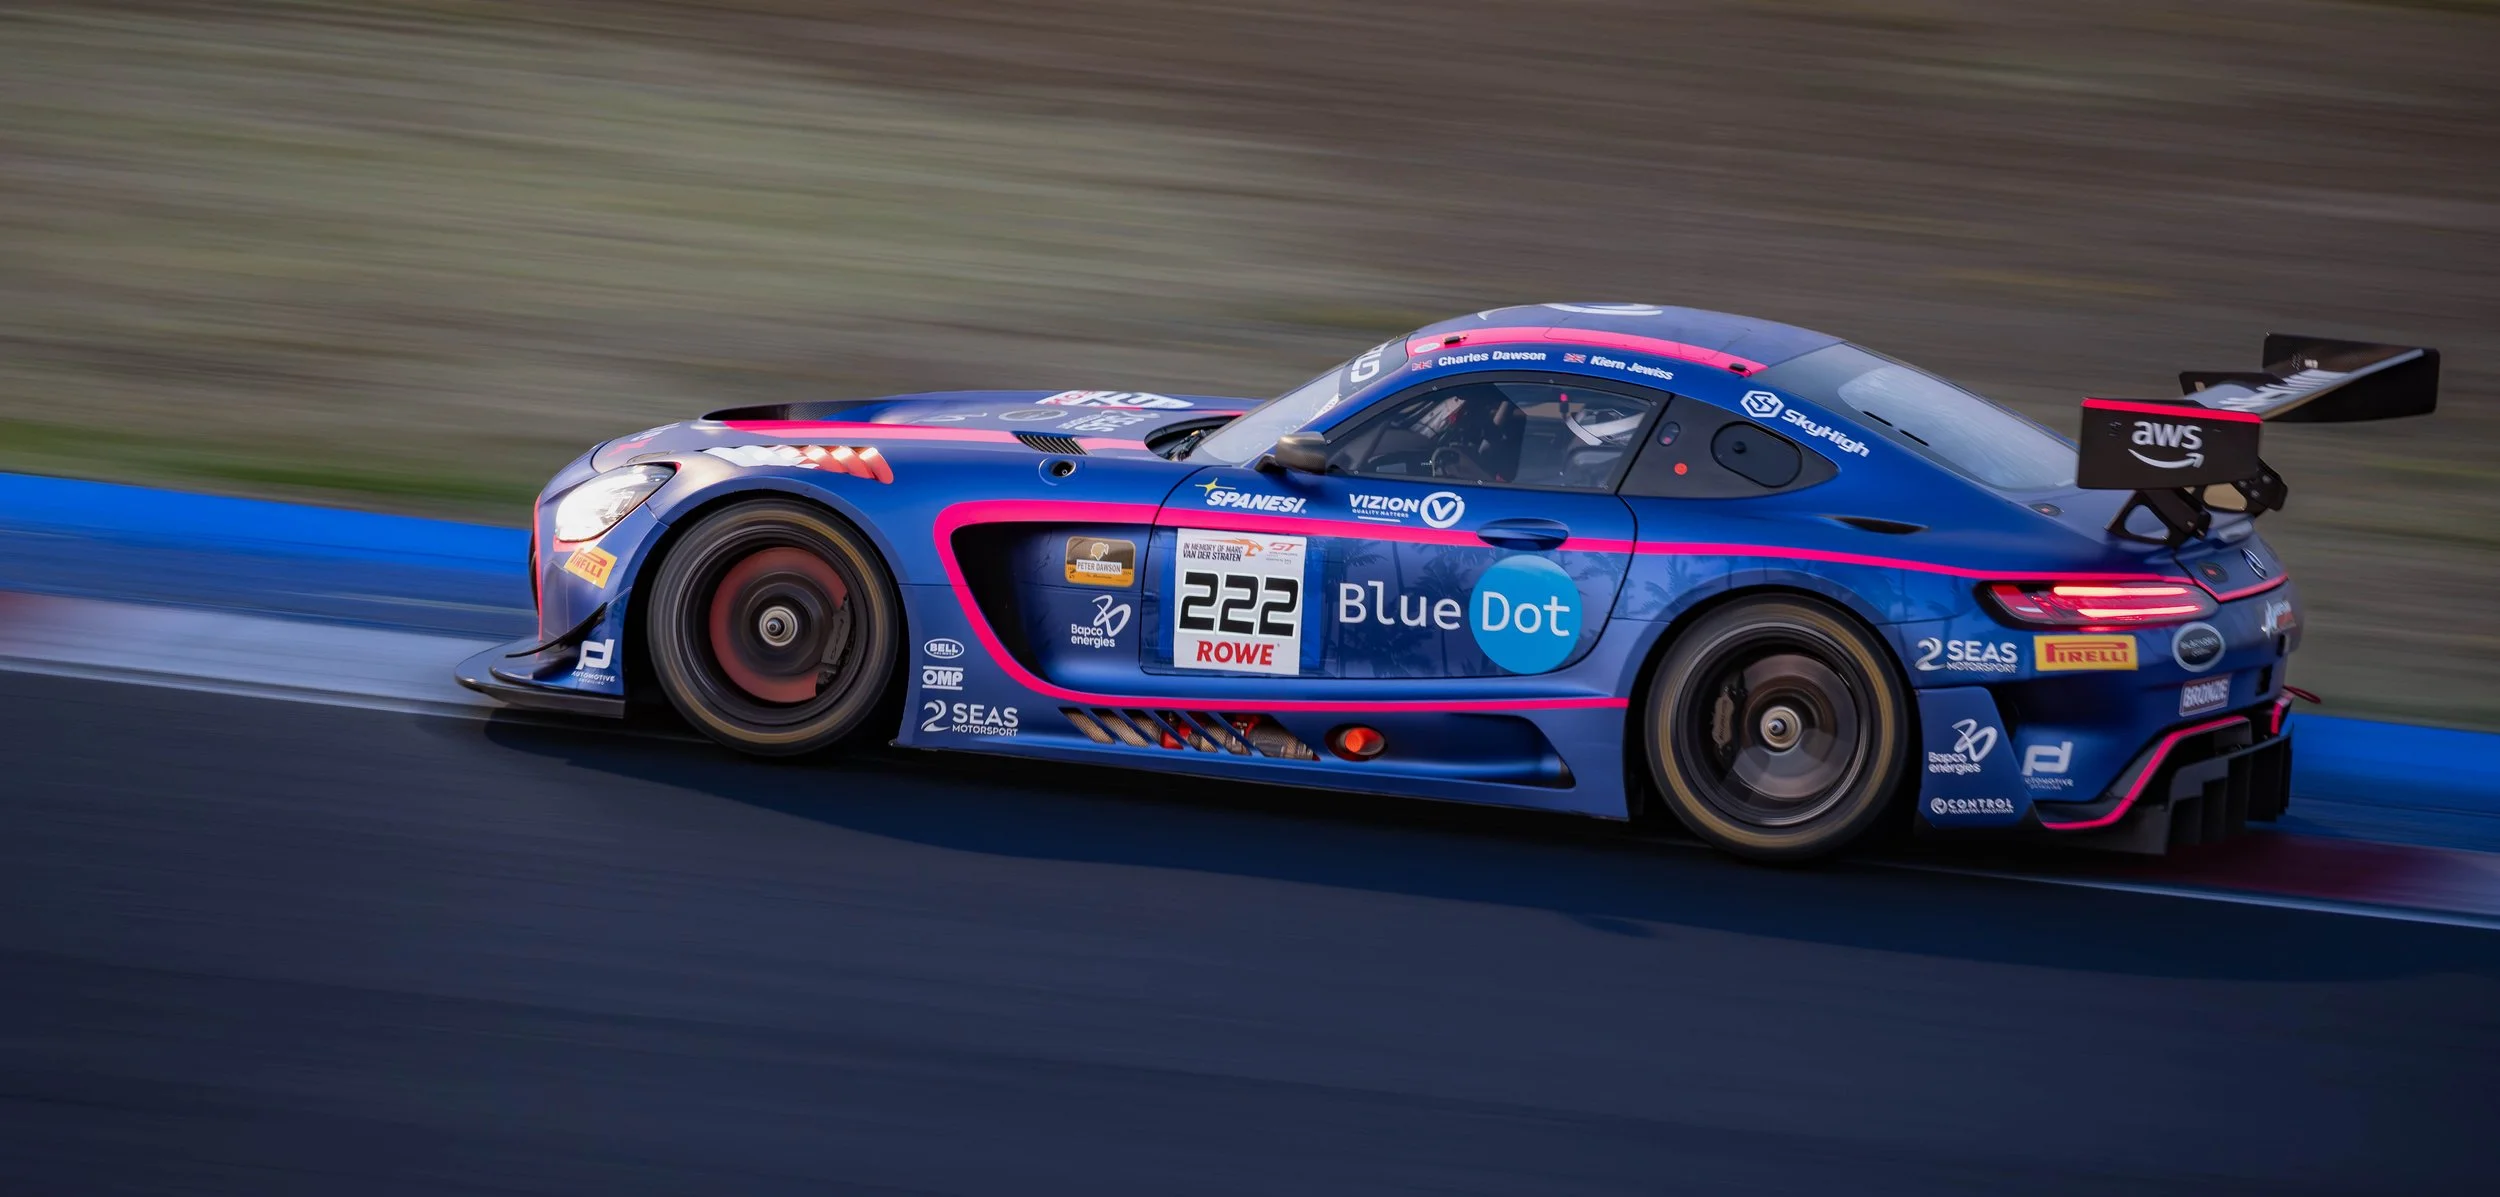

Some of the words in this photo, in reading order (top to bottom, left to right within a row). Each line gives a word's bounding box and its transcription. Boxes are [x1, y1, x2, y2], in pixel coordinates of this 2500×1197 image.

[1438, 352, 1489, 367] Charles
[1492, 350, 1546, 362] Dawson
[1590, 355, 1625, 370] Kiern
[1627, 361, 1674, 381] Jewiss
[1781, 408, 1870, 458] SkyHigh
[2131, 420, 2203, 451] aws
[1207, 491, 1306, 514] SPANESI
[1348, 493, 1420, 513] VIZION
[1191, 542, 1216, 551] MEMORY
[1183, 550, 1196, 558] VAN
[1197, 551, 1211, 560] DER
[1211, 552, 1242, 562] STRATEN
[1077, 561, 1095, 571] PETER
[1096, 562, 1121, 573] DAWSON
[1178, 570, 1299, 638] 222
[1339, 580, 1462, 631] Blue
[1482, 591, 1571, 637] Dot
[1071, 623, 1103, 637] Bapco
[929, 643, 958, 653] BELL
[1071, 636, 1116, 649] energies
[1196, 640, 1275, 666] ROWE
[1946, 639, 2018, 665] SEAS
[2045, 641, 2129, 663] PIRELLI
[571, 671, 615, 683] AUTOMOTIVE
[922, 669, 964, 687] OMP
[952, 702, 1019, 728] SEAS
[952, 724, 1018, 737] MOTORSPORT
[1928, 751, 1967, 766] Bapco
[1928, 763, 1981, 775] energies
[1947, 797, 2014, 810] CONTROL
